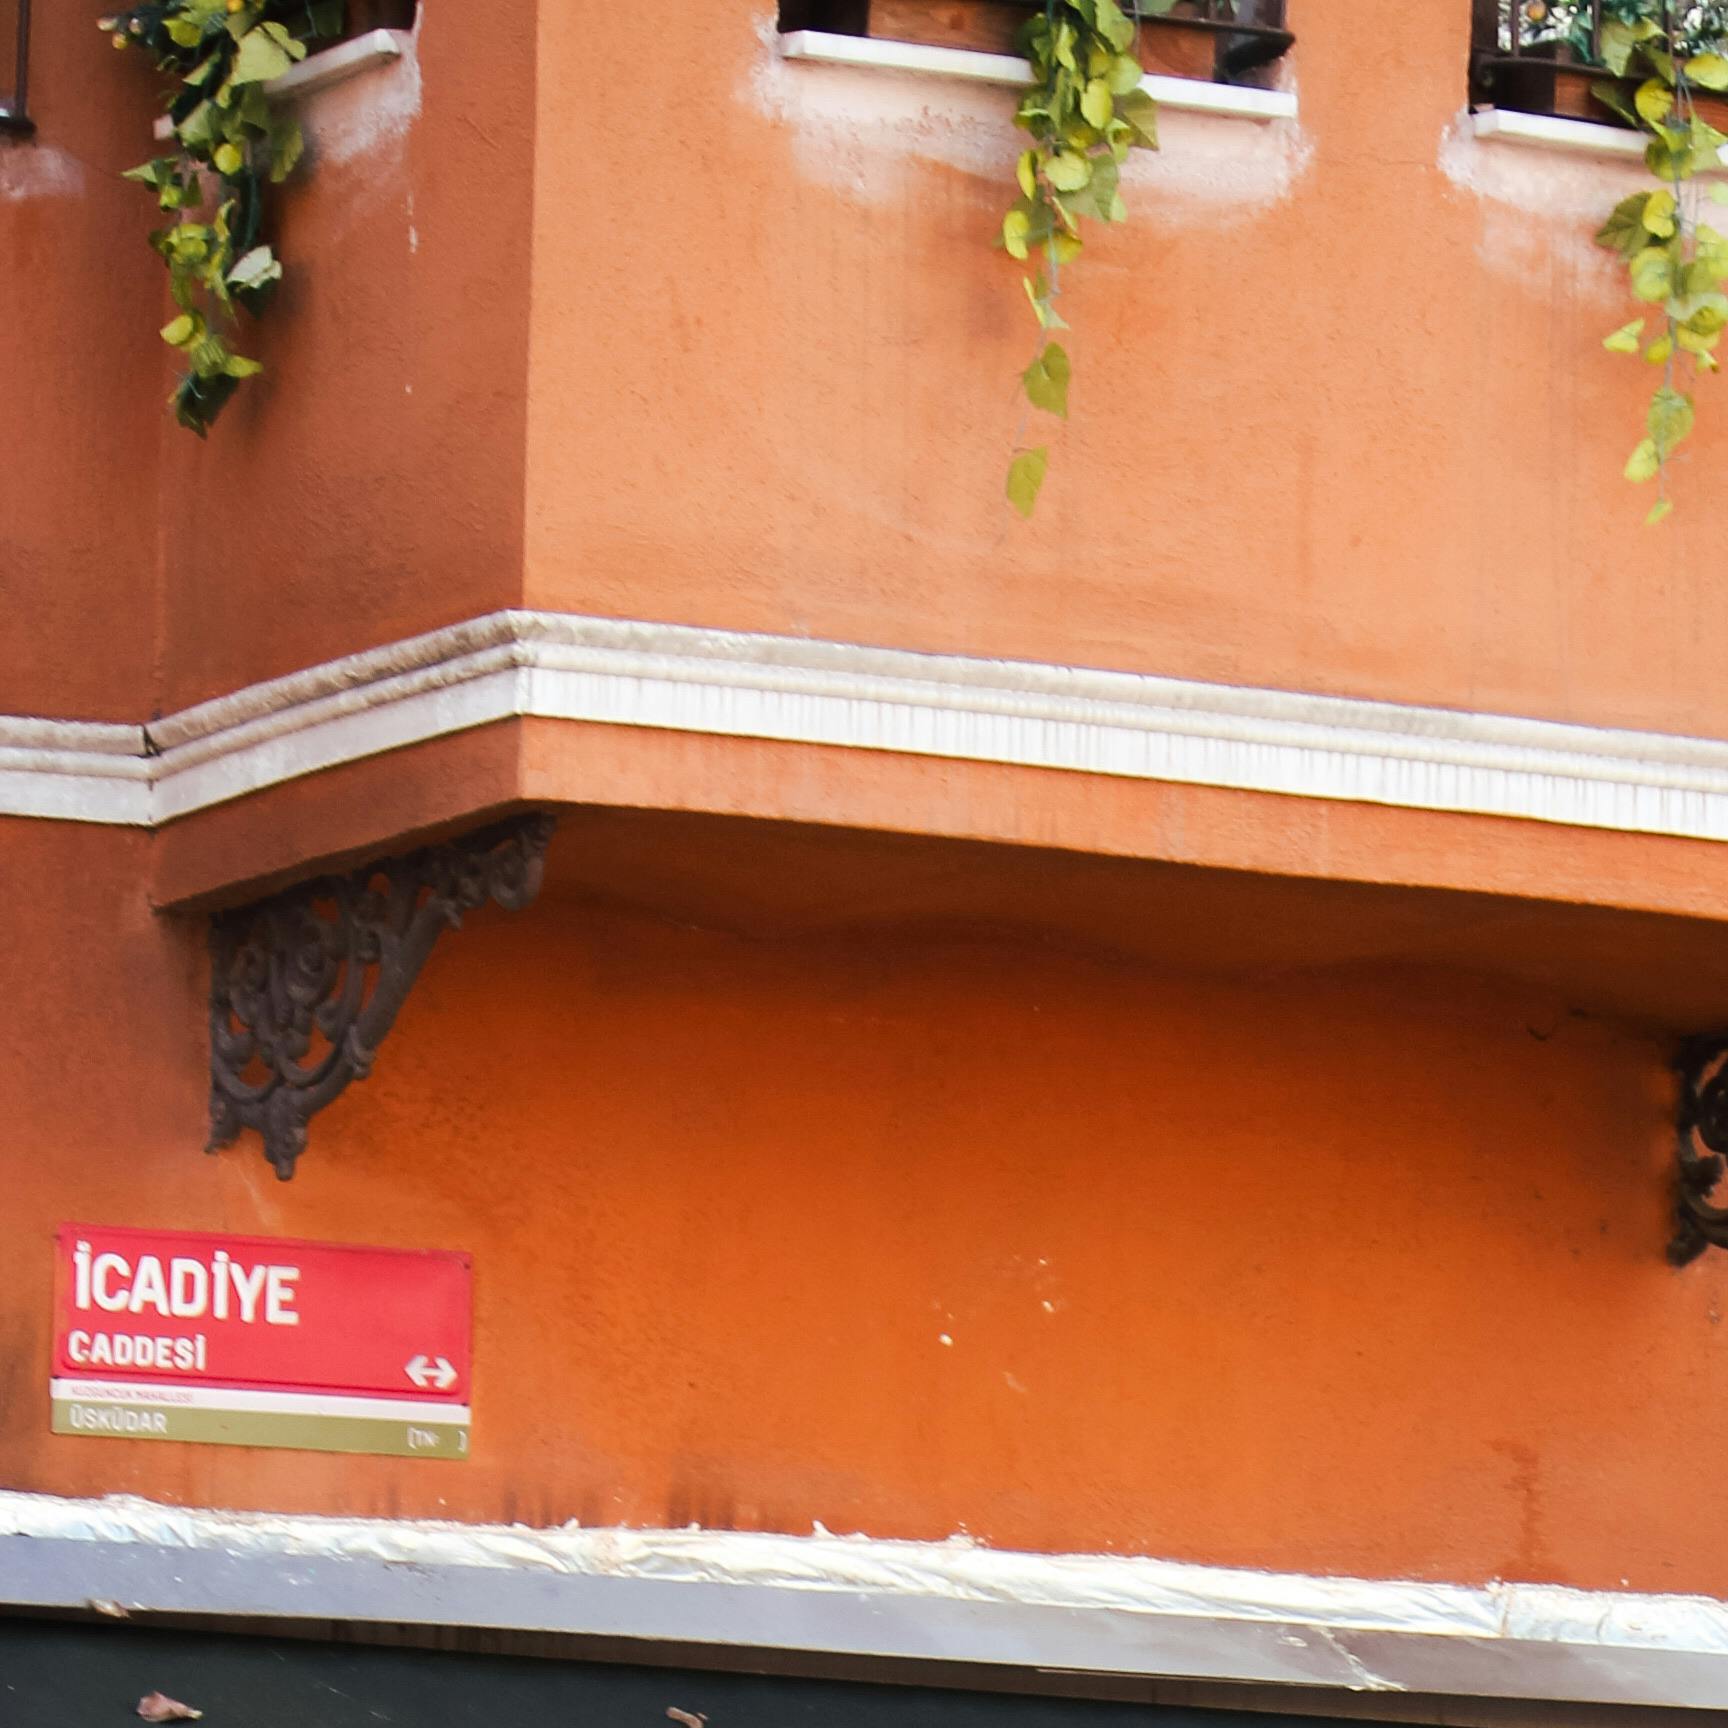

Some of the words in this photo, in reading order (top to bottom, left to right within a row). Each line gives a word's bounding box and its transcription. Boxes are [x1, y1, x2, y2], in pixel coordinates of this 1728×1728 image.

[73, 1239, 301, 1326] İCADİYE
[67, 1329, 207, 1372] CADDESİ
[69, 1403, 168, 1434] ÜSKÜDAR
